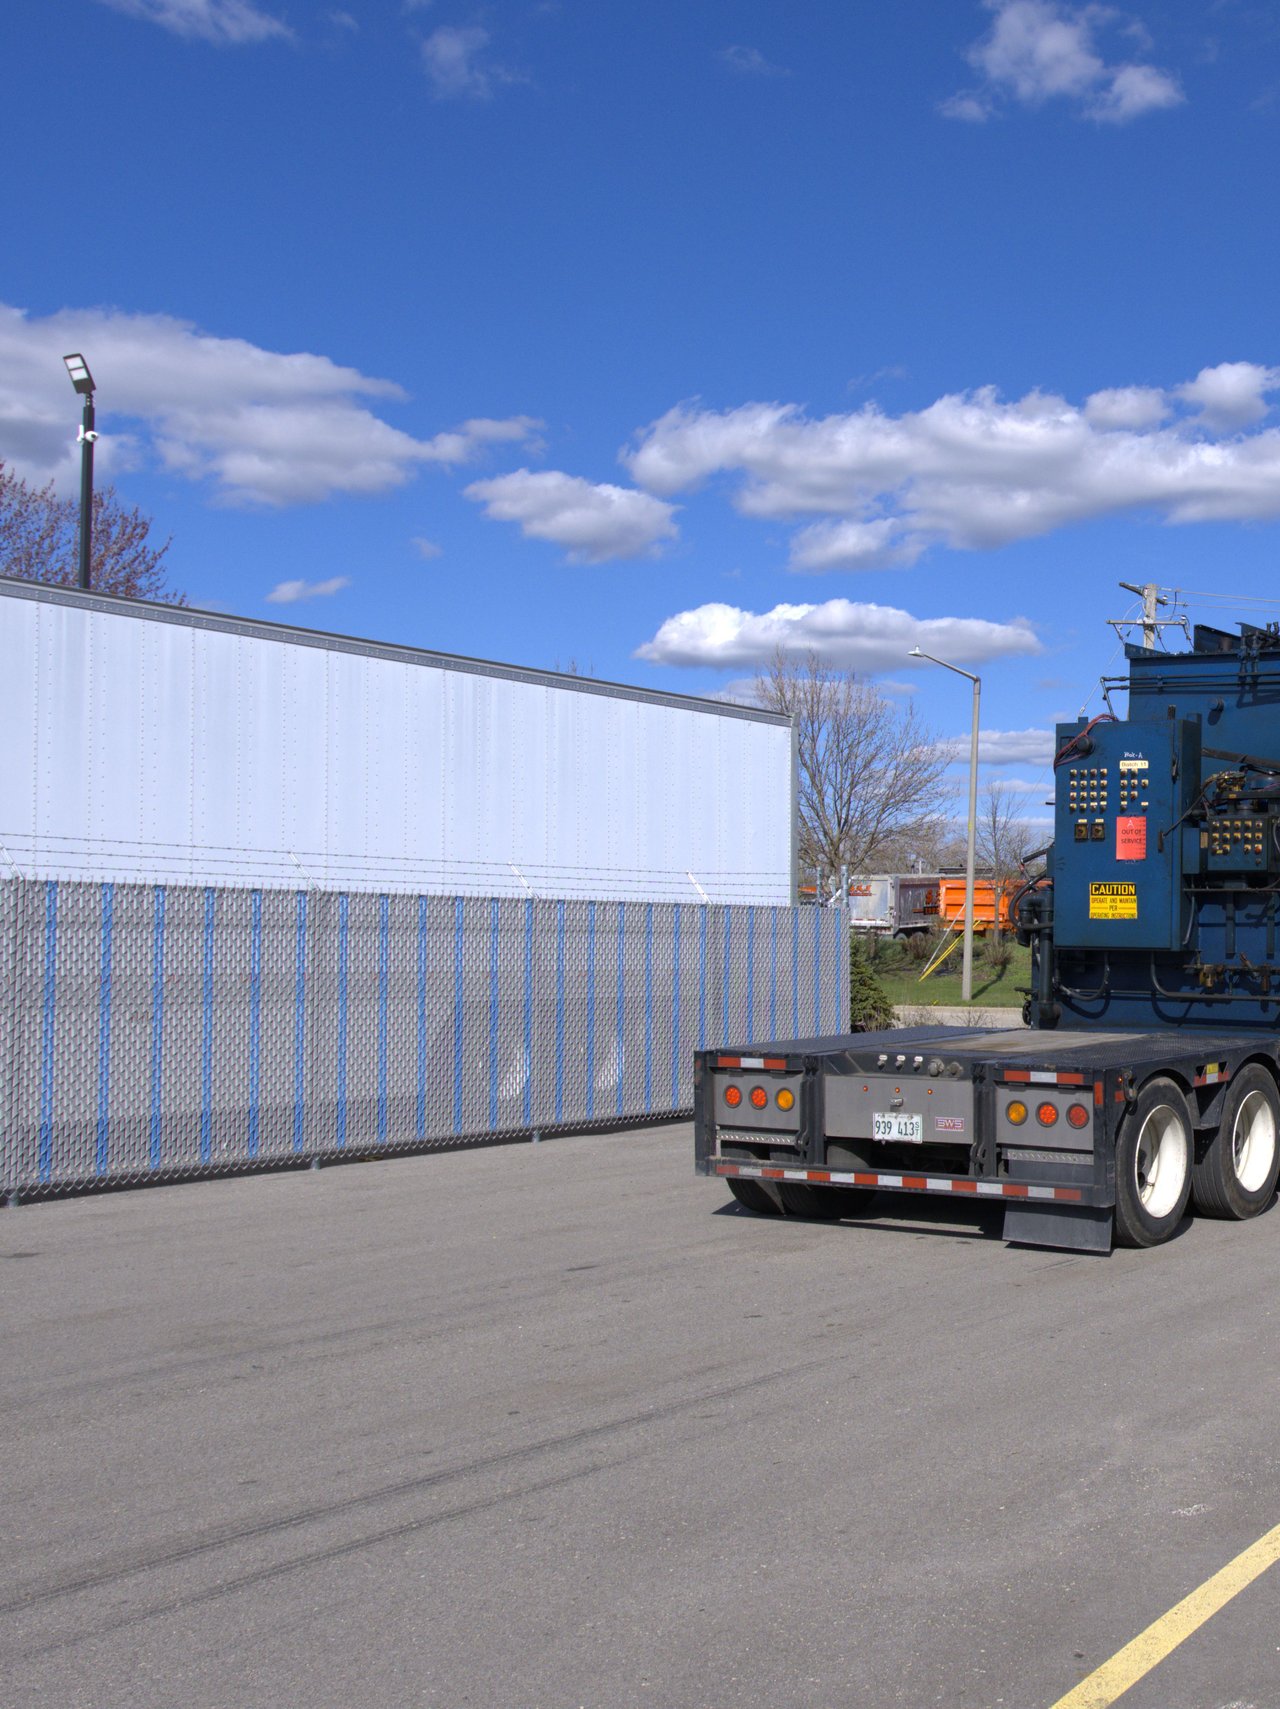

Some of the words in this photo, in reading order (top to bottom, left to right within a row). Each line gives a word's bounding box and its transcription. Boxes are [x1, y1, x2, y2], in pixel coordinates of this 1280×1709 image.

[1092, 884, 1135, 894] CAUTION
[875, 1120, 892, 1135] 939
[897, 1121, 915, 1136] 413
